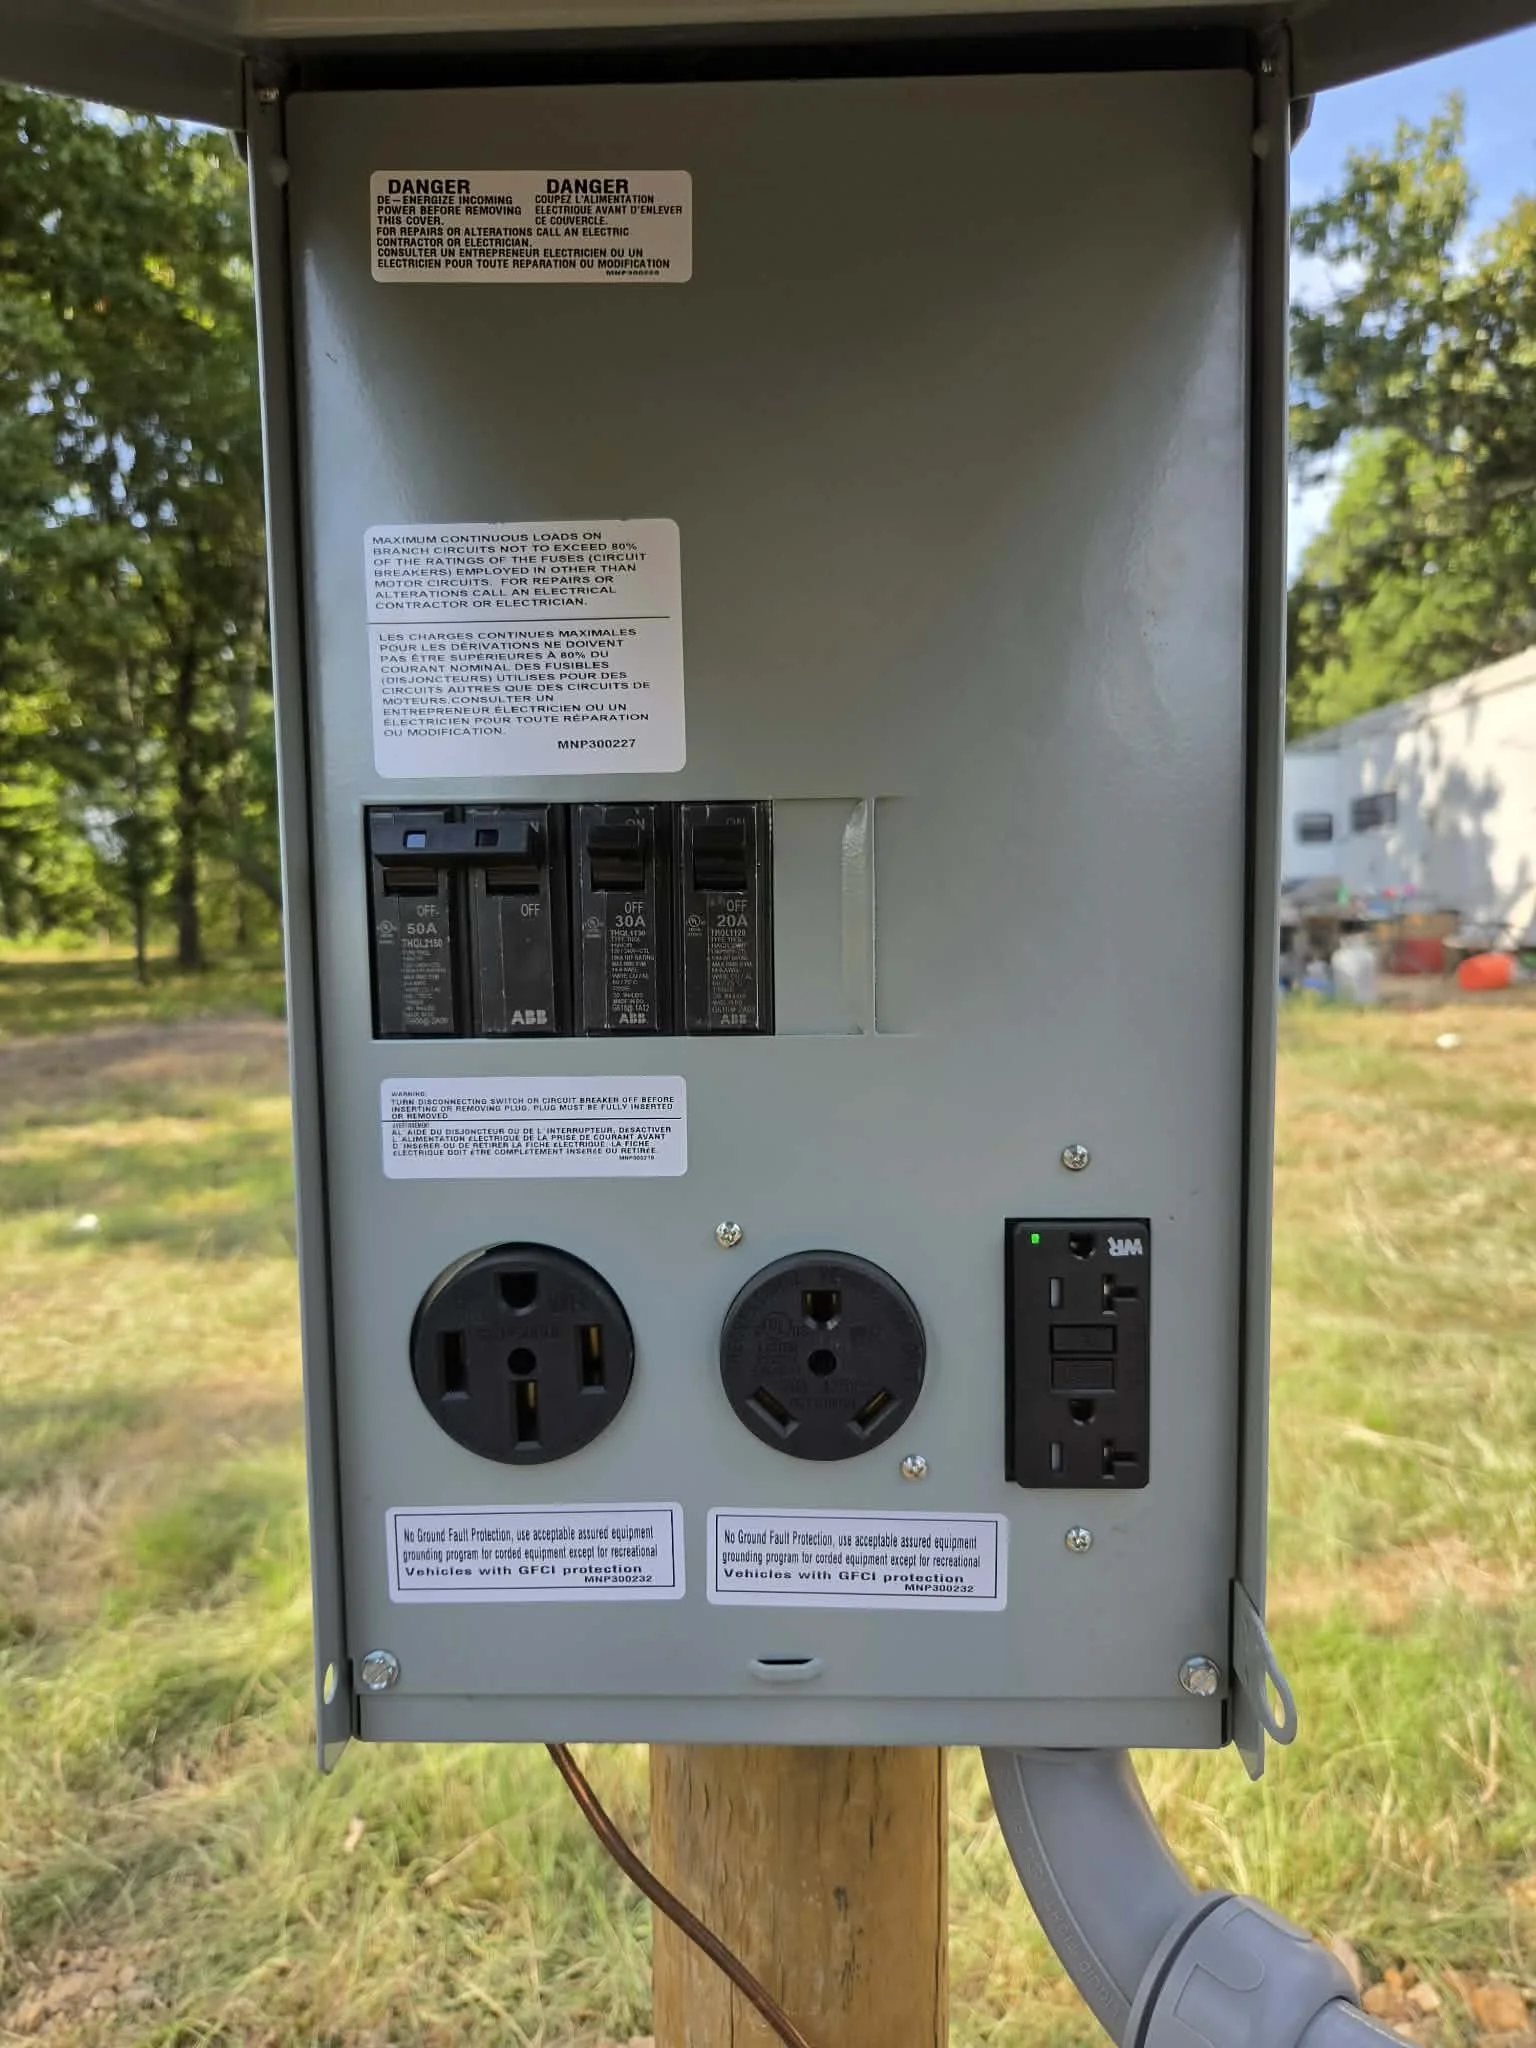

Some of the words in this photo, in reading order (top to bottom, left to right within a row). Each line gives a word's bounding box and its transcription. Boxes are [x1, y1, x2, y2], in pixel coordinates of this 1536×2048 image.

[388, 179, 469, 194] DANGER
[546, 179, 628, 193] DANGER
[458, 196, 512, 204] INCOMING
[534, 195, 571, 204] COUPEZ
[575, 195, 653, 204] L'ALIMENTATION
[377, 206, 415, 215] POWER
[420, 206, 460, 215] BEFORE
[465, 206, 521, 215] REMOVING
[534, 206, 592, 214] ELECTRIQUE
[595, 206, 625, 214] AVANT
[630, 206, 682, 214] D'ENLEVER
[378, 217, 402, 225] THIS
[534, 217, 546, 225] CE
[376, 228, 396, 236] FOR
[399, 228, 443, 236] REPAIRS
[446, 228, 460, 236] OR
[464, 228, 532, 236] ALTERATIONS
[536, 228, 560, 236] CALL
[563, 228, 578, 236] AN
[582, 228, 628, 236] ELECTRIC
[376, 238, 443, 247] CONTRACTOR
[446, 238, 460, 247] OR
[377, 249, 436, 257] CONSULTER
[440, 249, 455, 257] UN
[459, 249, 539, 257] ENTREPRENEUR
[543, 249, 606, 257] ELECTRICIEN
[610, 249, 624, 257] OU
[628, 249, 642, 257] UN
[377, 259, 441, 268] ELECTRICIEN
[444, 259, 472, 268] POUR
[477, 259, 508, 268] TOUTE
[512, 259, 576, 268] REPARATION
[579, 259, 594, 268] OU
[597, 259, 669, 268] MODIFICATION
[373, 535, 436, 544] MAXIMUM
[441, 534, 528, 543] CONTINUOUS
[533, 533, 578, 541] LOADS
[583, 532, 601, 540] ON
[374, 546, 429, 555] BRANCH
[434, 545, 495, 554] CIRCUITS
[501, 544, 527, 552] NOT
[533, 544, 550, 552] TO
[554, 543, 606, 551] EXCEED
[612, 542, 637, 550] 80%
[374, 558, 392, 566] OF
[399, 557, 421, 565] THE
[426, 556, 484, 565] RATINGS
[512, 555, 536, 563] THE
[541, 554, 584, 562] FUSES
[589, 553, 646, 561] (CIRCUIT
[375, 568, 451, 576] BREAKERS)
[456, 566, 528, 575] EMPLOYED
[551, 565, 596, 573] OTHER
[601, 564, 636, 572] THAN
[375, 579, 422, 587] MOTOR
[501, 577, 527, 585] FOR
[533, 576, 589, 584] REPAIRS
[594, 575, 613, 583] OR
[375, 589, 468, 598] ALTERATIONS
[472, 588, 506, 596] CALL
[534, 586, 616, 595] ELECTRICAL
[376, 600, 468, 609] CONTRACTOR
[473, 599, 491, 607] OR
[379, 633, 404, 641] LES
[409, 632, 473, 640] CHARGES
[478, 630, 554, 639] CONTINUES
[559, 629, 637, 638] MAXIMALES
[381, 665, 444, 673] COURANT
[450, 663, 509, 672] NOMINAL
[515, 663, 540, 671] DES
[545, 662, 609, 670] FUSIBLES
[383, 686, 442, 694] CIRCUITS
[448, 685, 500, 693] AUTRES
[505, 684, 532, 692] QUE
[537, 683, 563, 691] DES
[567, 682, 629, 691] CIRCUITS
[557, 739, 635, 750] MNP300227
[520, 903, 541, 917] OFF
[624, 901, 644, 914] OFF
[726, 899, 748, 913] OFF
[615, 914, 646, 928] 30A
[717, 914, 748, 928] 20A
[407, 922, 438, 935] 50A
[511, 1009, 548, 1025] ABB
[619, 1012, 647, 1025] ABB
[720, 1013, 747, 1026] ABB
[403, 1528, 414, 1542] No
[417, 1528, 445, 1542] Ground
[448, 1527, 468, 1541] Fault
[516, 1529, 530, 1541] use
[532, 1526, 574, 1542] acceptable
[578, 1526, 608, 1540] assured
[611, 1525, 652, 1541] equipment
[724, 1530, 734, 1544] No
[738, 1531, 766, 1545] Ground
[769, 1531, 789, 1545] Fault
[838, 1535, 851, 1547] use
[854, 1533, 897, 1550] acceptable
[900, 1534, 931, 1549] assured
[934, 1535, 978, 1552] equipment
[403, 1549, 442, 1562] grounding
[446, 1551, 478, 1561] program
[481, 1548, 491, 1559] for
[495, 1548, 521, 1559] corded
[524, 1547, 565, 1560] equipment
[569, 1547, 594, 1559] except
[597, 1546, 607, 1557] for
[610, 1546, 657, 1557] recreational
[722, 1551, 762, 1565] grounding
[765, 1555, 798, 1565] program
[801, 1553, 811, 1564] for
[815, 1553, 842, 1564] corded
[845, 1554, 887, 1567] equipment
[890, 1555, 916, 1568] except
[919, 1555, 929, 1566] for
[932, 1556, 980, 1567] recreational
[405, 1567, 472, 1576] Vehicles
[478, 1566, 512, 1575] with
[518, 1566, 556, 1575] GFCI
[562, 1565, 642, 1575] protection
[724, 1569, 791, 1580] Vehicles
[798, 1571, 831, 1580] with
[838, 1572, 876, 1581] GFCI
[883, 1572, 964, 1583] protection
[904, 1584, 974, 1592] MNP300232
